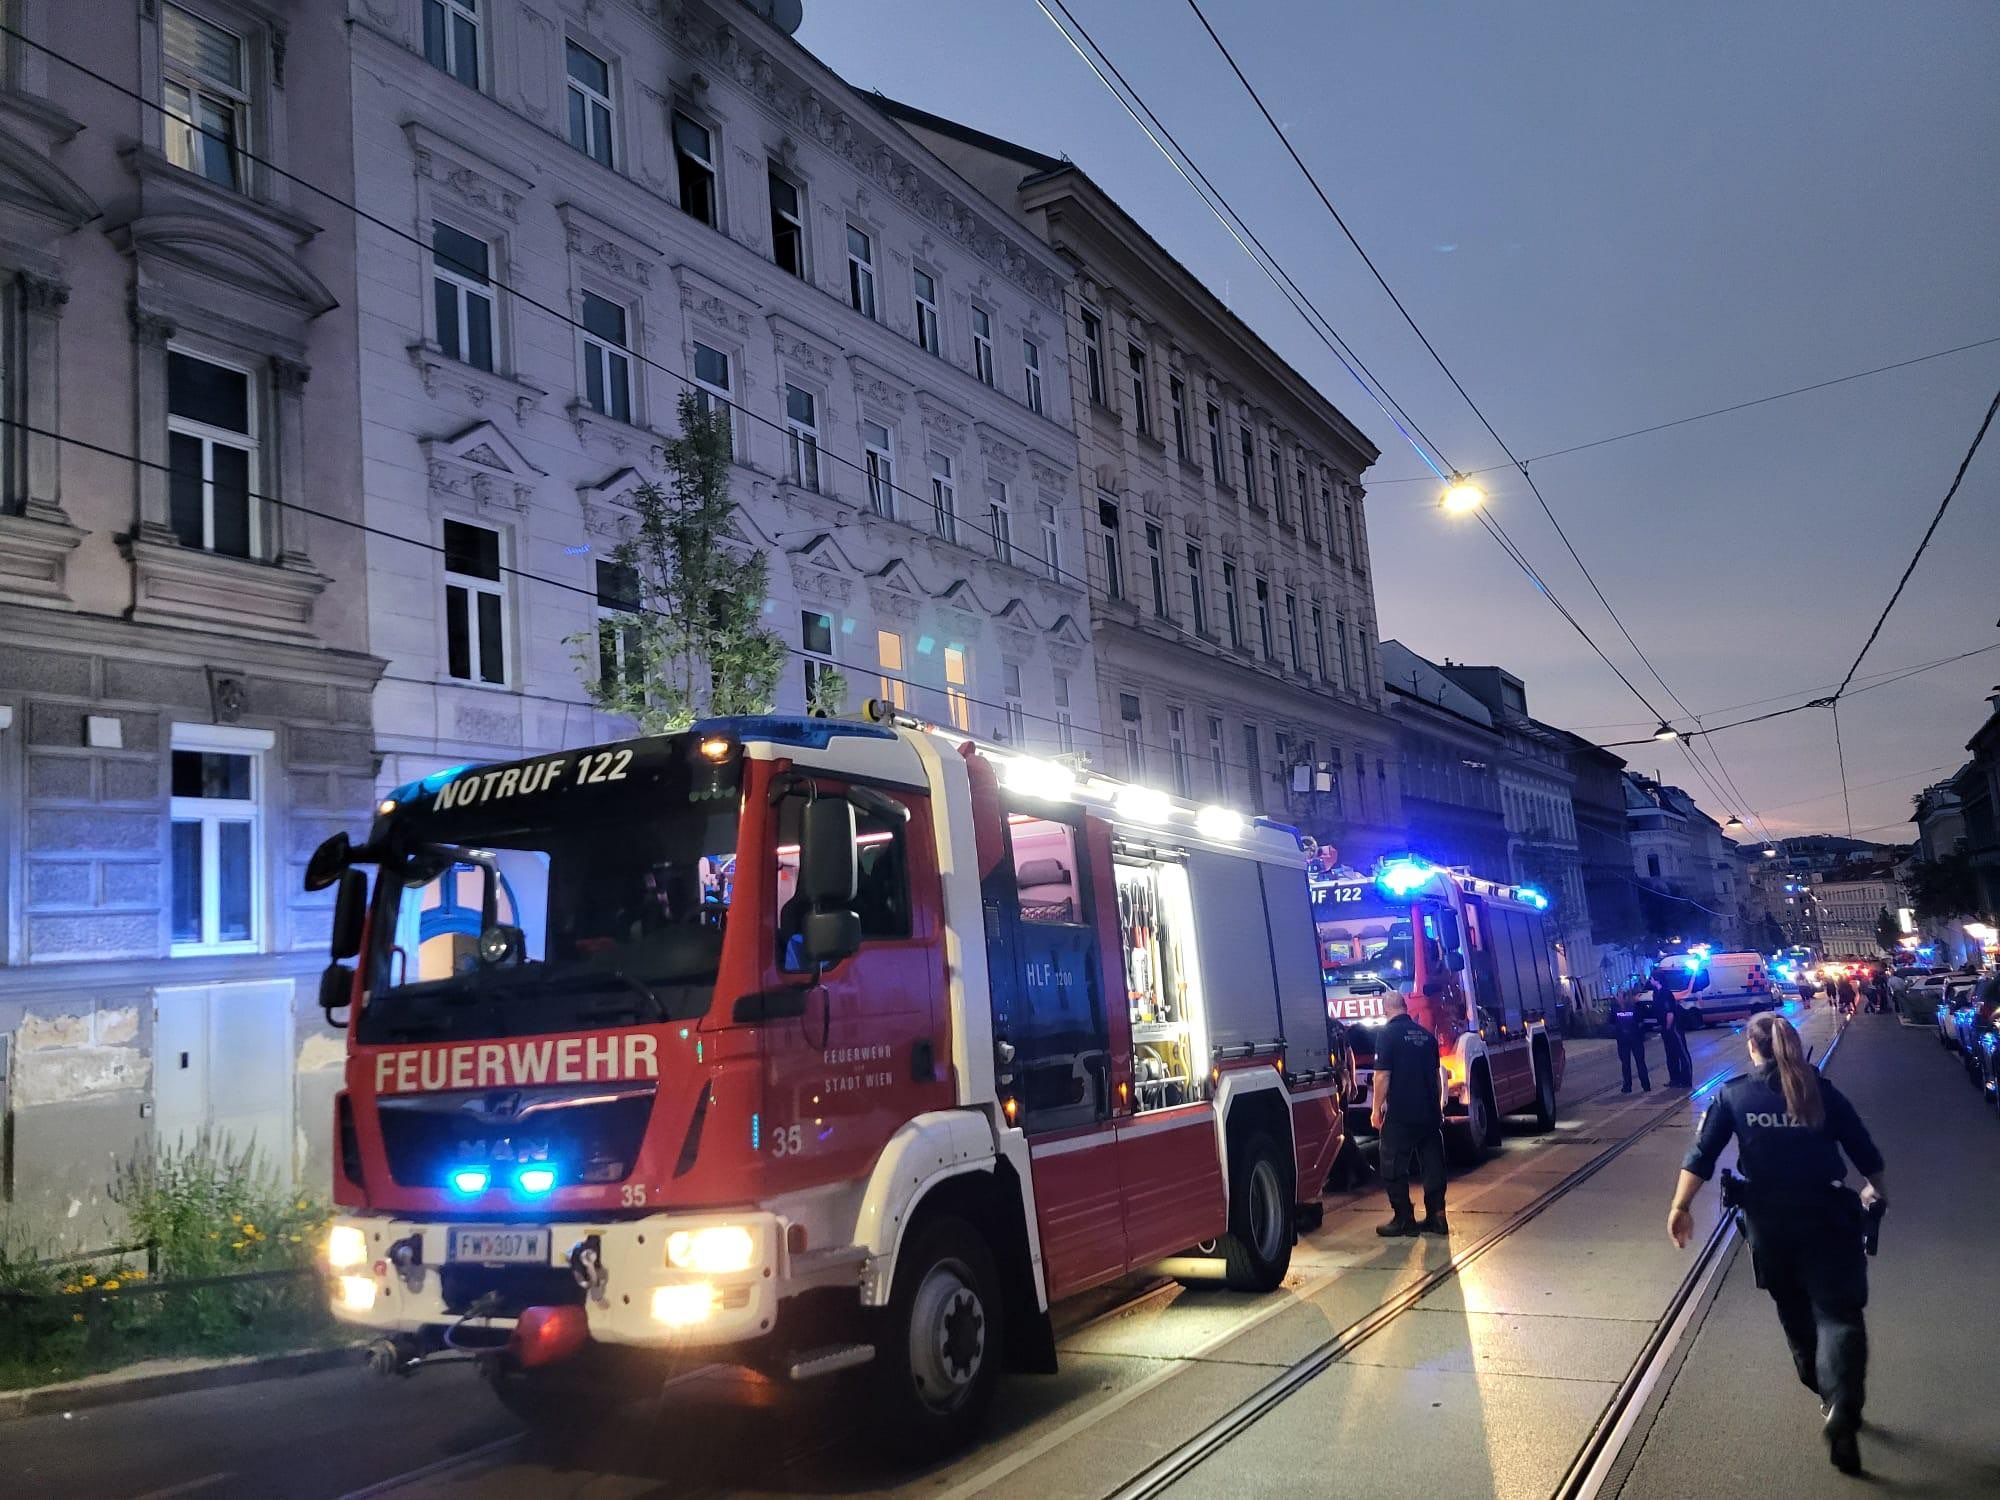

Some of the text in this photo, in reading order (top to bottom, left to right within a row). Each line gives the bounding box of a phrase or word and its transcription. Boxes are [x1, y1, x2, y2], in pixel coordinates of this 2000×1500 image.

[432, 749, 634, 813] NOTRUF 122
[1334, 887, 1362, 902] 122
[1026, 963, 1051, 986] HLF
[374, 1033, 659, 1092] FEUERWEHR
[823, 1045, 892, 1064] FEUERWEHR
[825, 1072, 893, 1093] STADT WIEN
[458, 1138, 549, 1163] MAN
[772, 1124, 802, 1158] 35
[620, 1184, 647, 1207] 35
